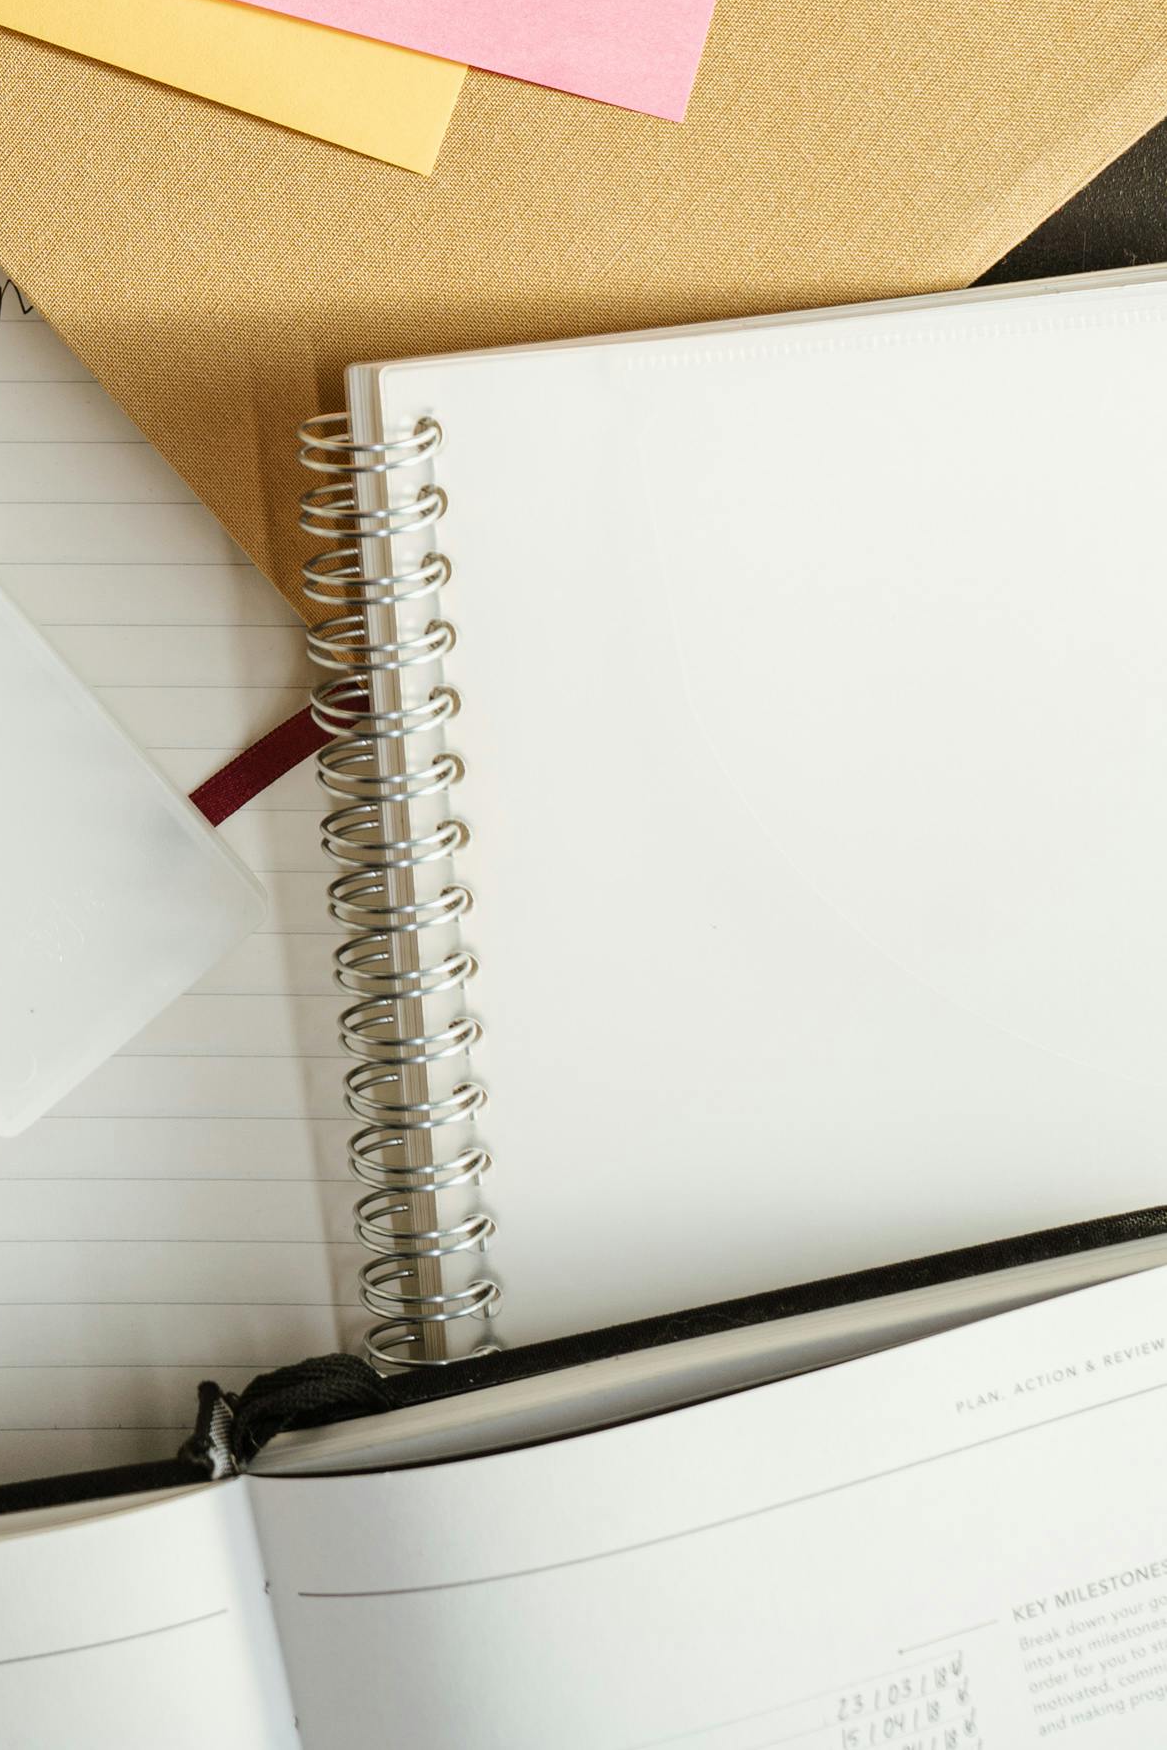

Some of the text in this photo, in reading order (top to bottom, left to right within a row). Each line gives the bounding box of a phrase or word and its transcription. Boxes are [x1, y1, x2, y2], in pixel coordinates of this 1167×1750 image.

[1013, 1365, 1079, 1396] ACTION
[1084, 1359, 1097, 1373] &
[1102, 1337, 1167, 1367] REVIEW
[1011, 1598, 1048, 1624] KEY
